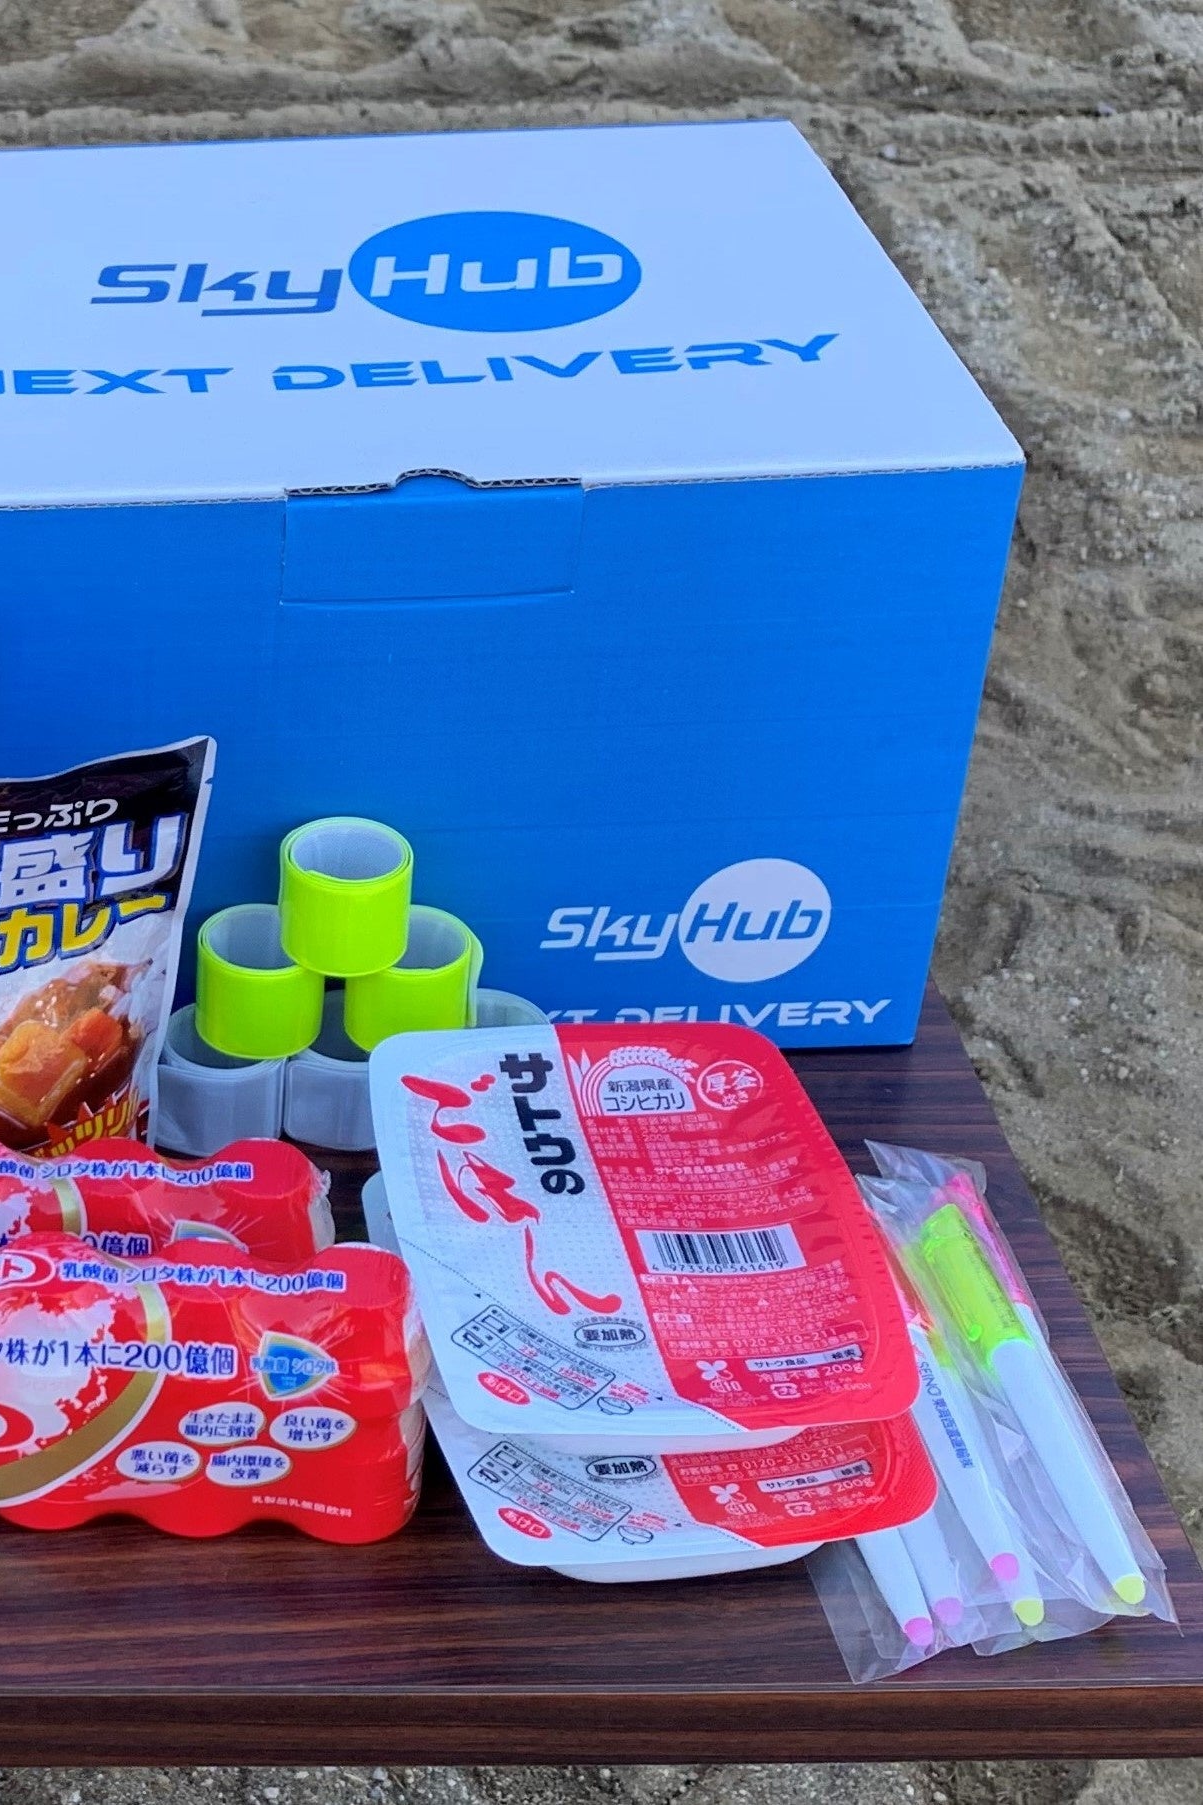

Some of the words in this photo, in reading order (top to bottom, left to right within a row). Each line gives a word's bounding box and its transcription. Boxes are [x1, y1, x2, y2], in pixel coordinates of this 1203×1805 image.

[90, 244, 632, 317] SkyHub
[271, 332, 840, 391] DELIVERY
[540, 899, 824, 962] SkyHub
[607, 1077, 675, 1093] 新潟県産
[604, 1092, 686, 1113] コシヒカリ
[499, 1052, 586, 1196] サトウの
[400, 1073, 622, 1316] ごはん
[582, 1328, 637, 1341] 要加熱
[753, 1357, 809, 1368] サトウ食品
[823, 1362, 864, 1377] 200g
[187, 1410, 257, 1425] 生きたまま
[284, 1414, 347, 1431] 良い菌を
[287, 1429, 334, 1443] 増やす
[130, 1450, 195, 1466] 悪い菌を
[211, 1454, 286, 1469] 腸内環境を
[134, 1463, 182, 1475] 減らす
[230, 1468, 261, 1480] 改善
[593, 1459, 647, 1475] 要加熱
[765, 1475, 819, 1489] サトウ食品
[835, 1477, 876, 1493] 200g
